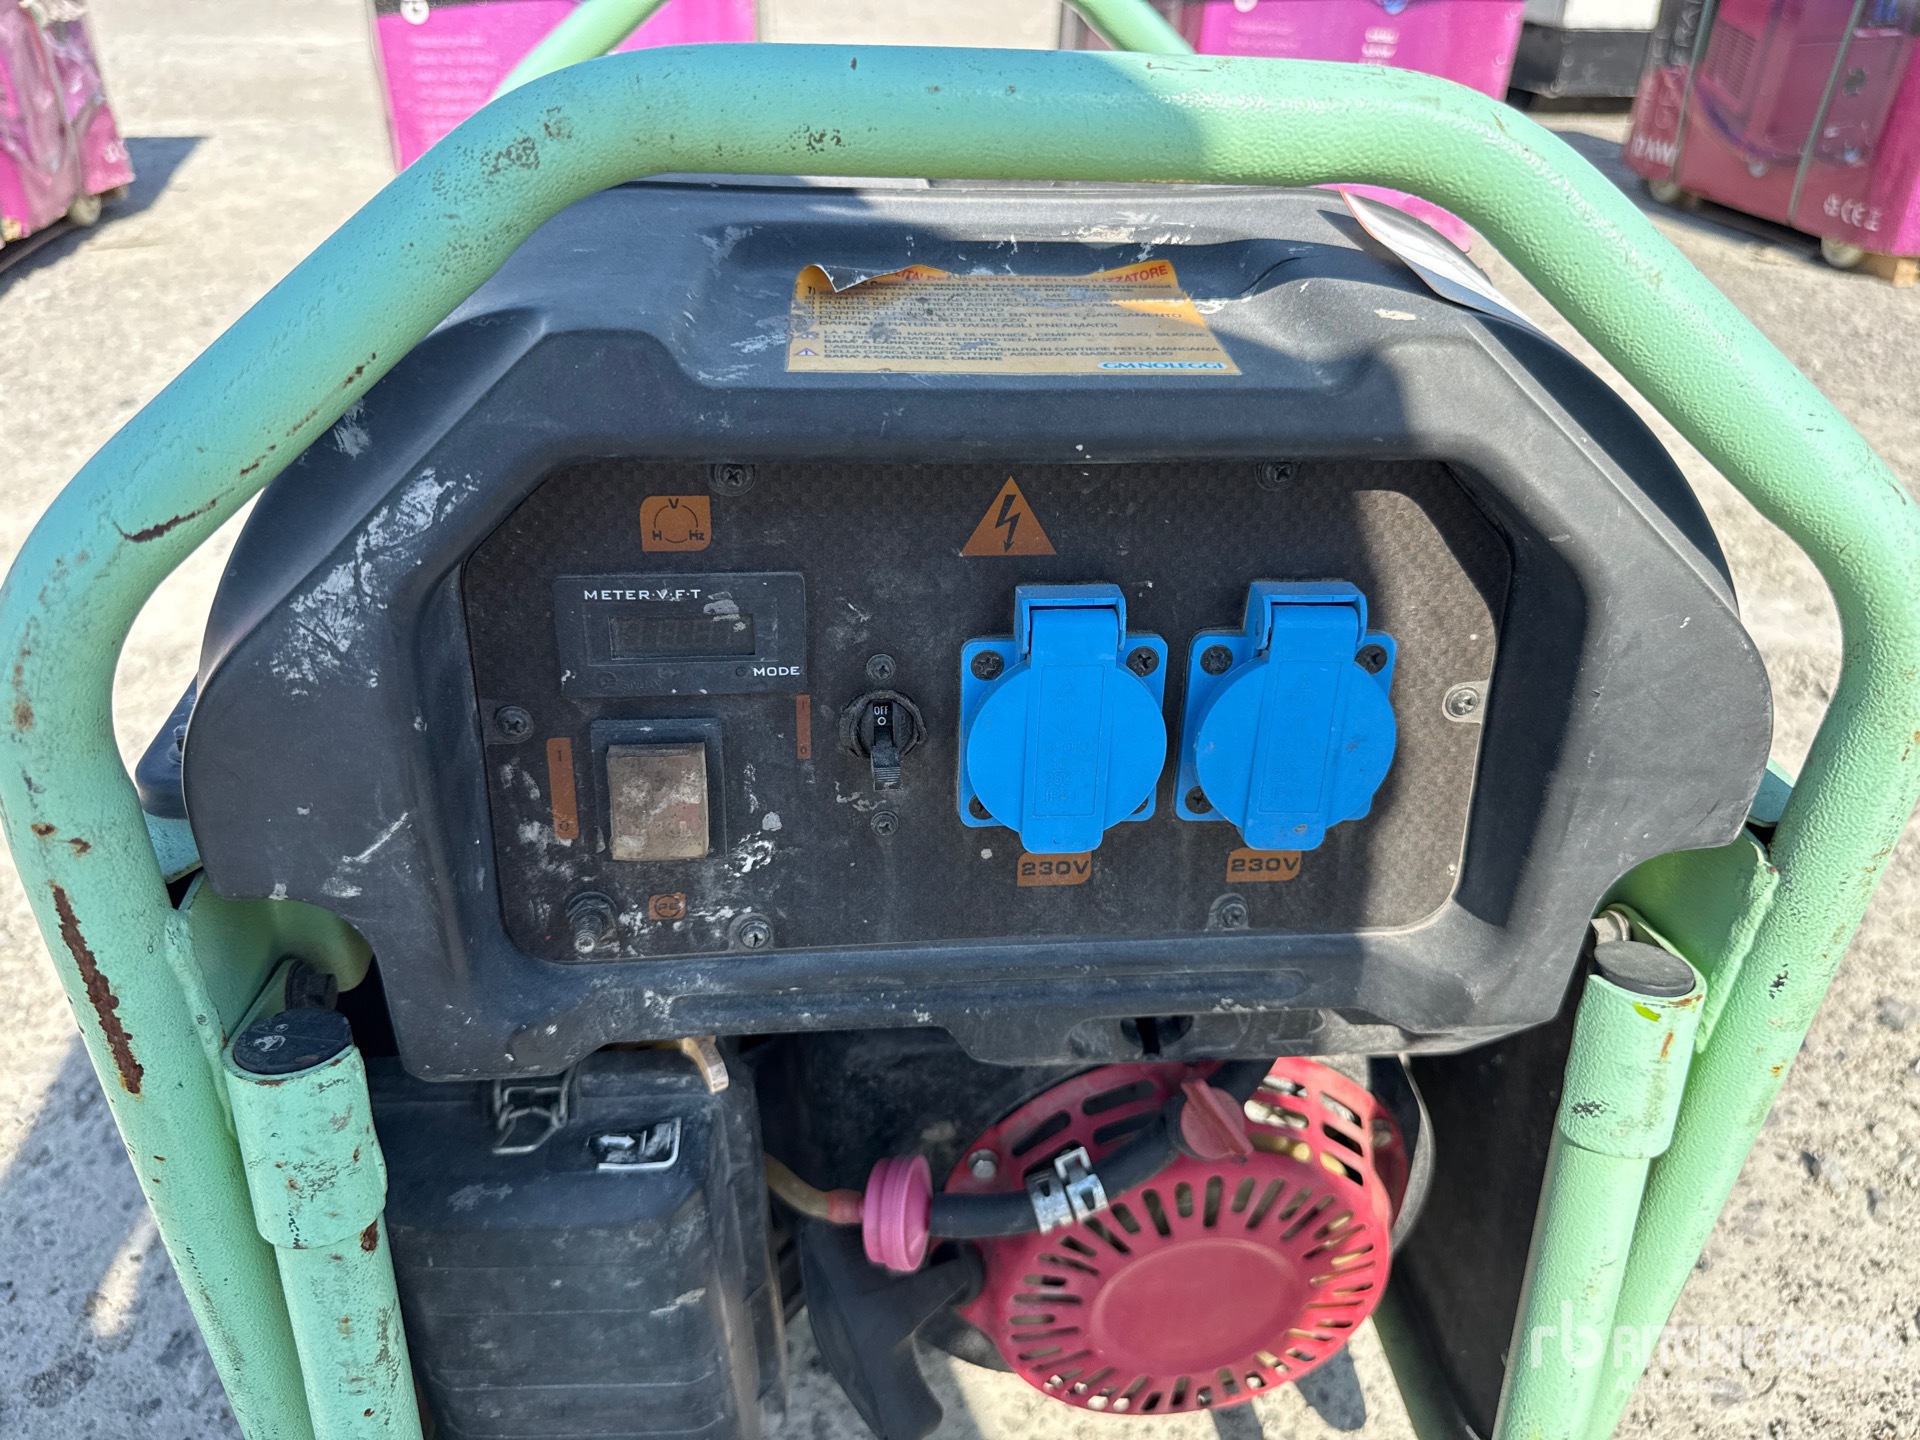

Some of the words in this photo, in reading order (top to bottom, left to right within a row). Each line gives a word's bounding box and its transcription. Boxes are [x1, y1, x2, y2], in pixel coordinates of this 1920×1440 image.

[668, 498, 679, 509] V
[652, 530, 662, 541] H
[689, 530, 705, 541] Hz
[752, 666, 800, 677] MODE
[873, 705, 889, 716] OFF
[1021, 860, 1090, 876] 230V
[1231, 857, 1300, 873] 230V
